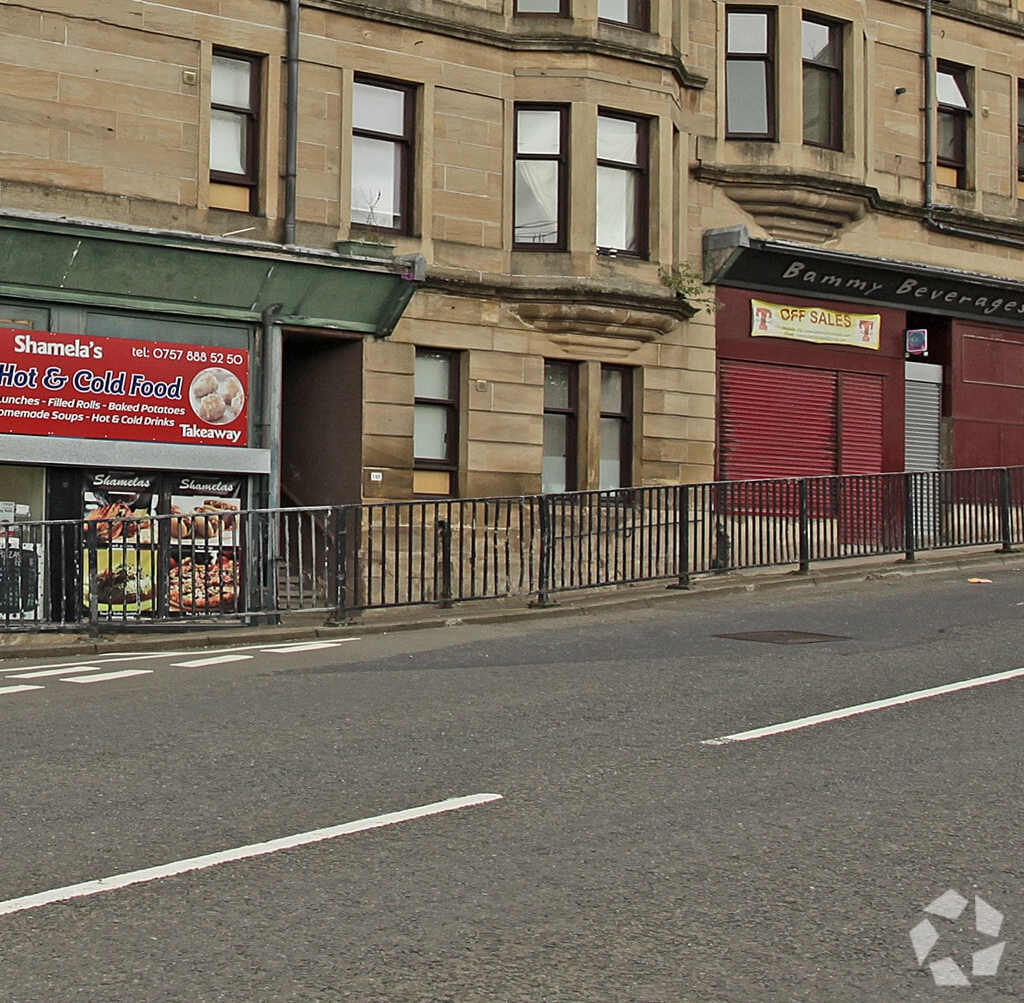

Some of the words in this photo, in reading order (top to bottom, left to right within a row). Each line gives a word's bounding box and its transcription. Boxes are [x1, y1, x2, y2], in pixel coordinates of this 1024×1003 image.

[782, 261, 883, 295] Bammy
[895, 278, 1024, 315] Beverages
[780, 308, 806, 323] OFF
[810, 310, 852, 328] SALES
[14, 335, 103, 359] Shamela's
[131, 347, 151, 358] tel:
[152, 348, 184, 361] 0757
[186, 351, 208, 363] 888
[209, 353, 225, 364] 52
[226, 355, 244, 365] 50
[42, 367, 68, 390] &
[73, 369, 126, 395] Cold
[129, 374, 183, 400] Food
[47, 398, 74, 409] Filled
[75, 400, 101, 411] Rolls
[108, 402, 139, 413] Baked
[140, 405, 186, 416] Potatoes
[51, 411, 84, 423] Soups
[91, 413, 110, 423] Hot
[111, 416, 120, 424] &
[121, 415, 143, 426] Cold
[144, 417, 175, 428] Drinks
[179, 424, 242, 443] Takeaway
[93, 474, 150, 488] Shamelas
[179, 479, 234, 492] Shamelas
